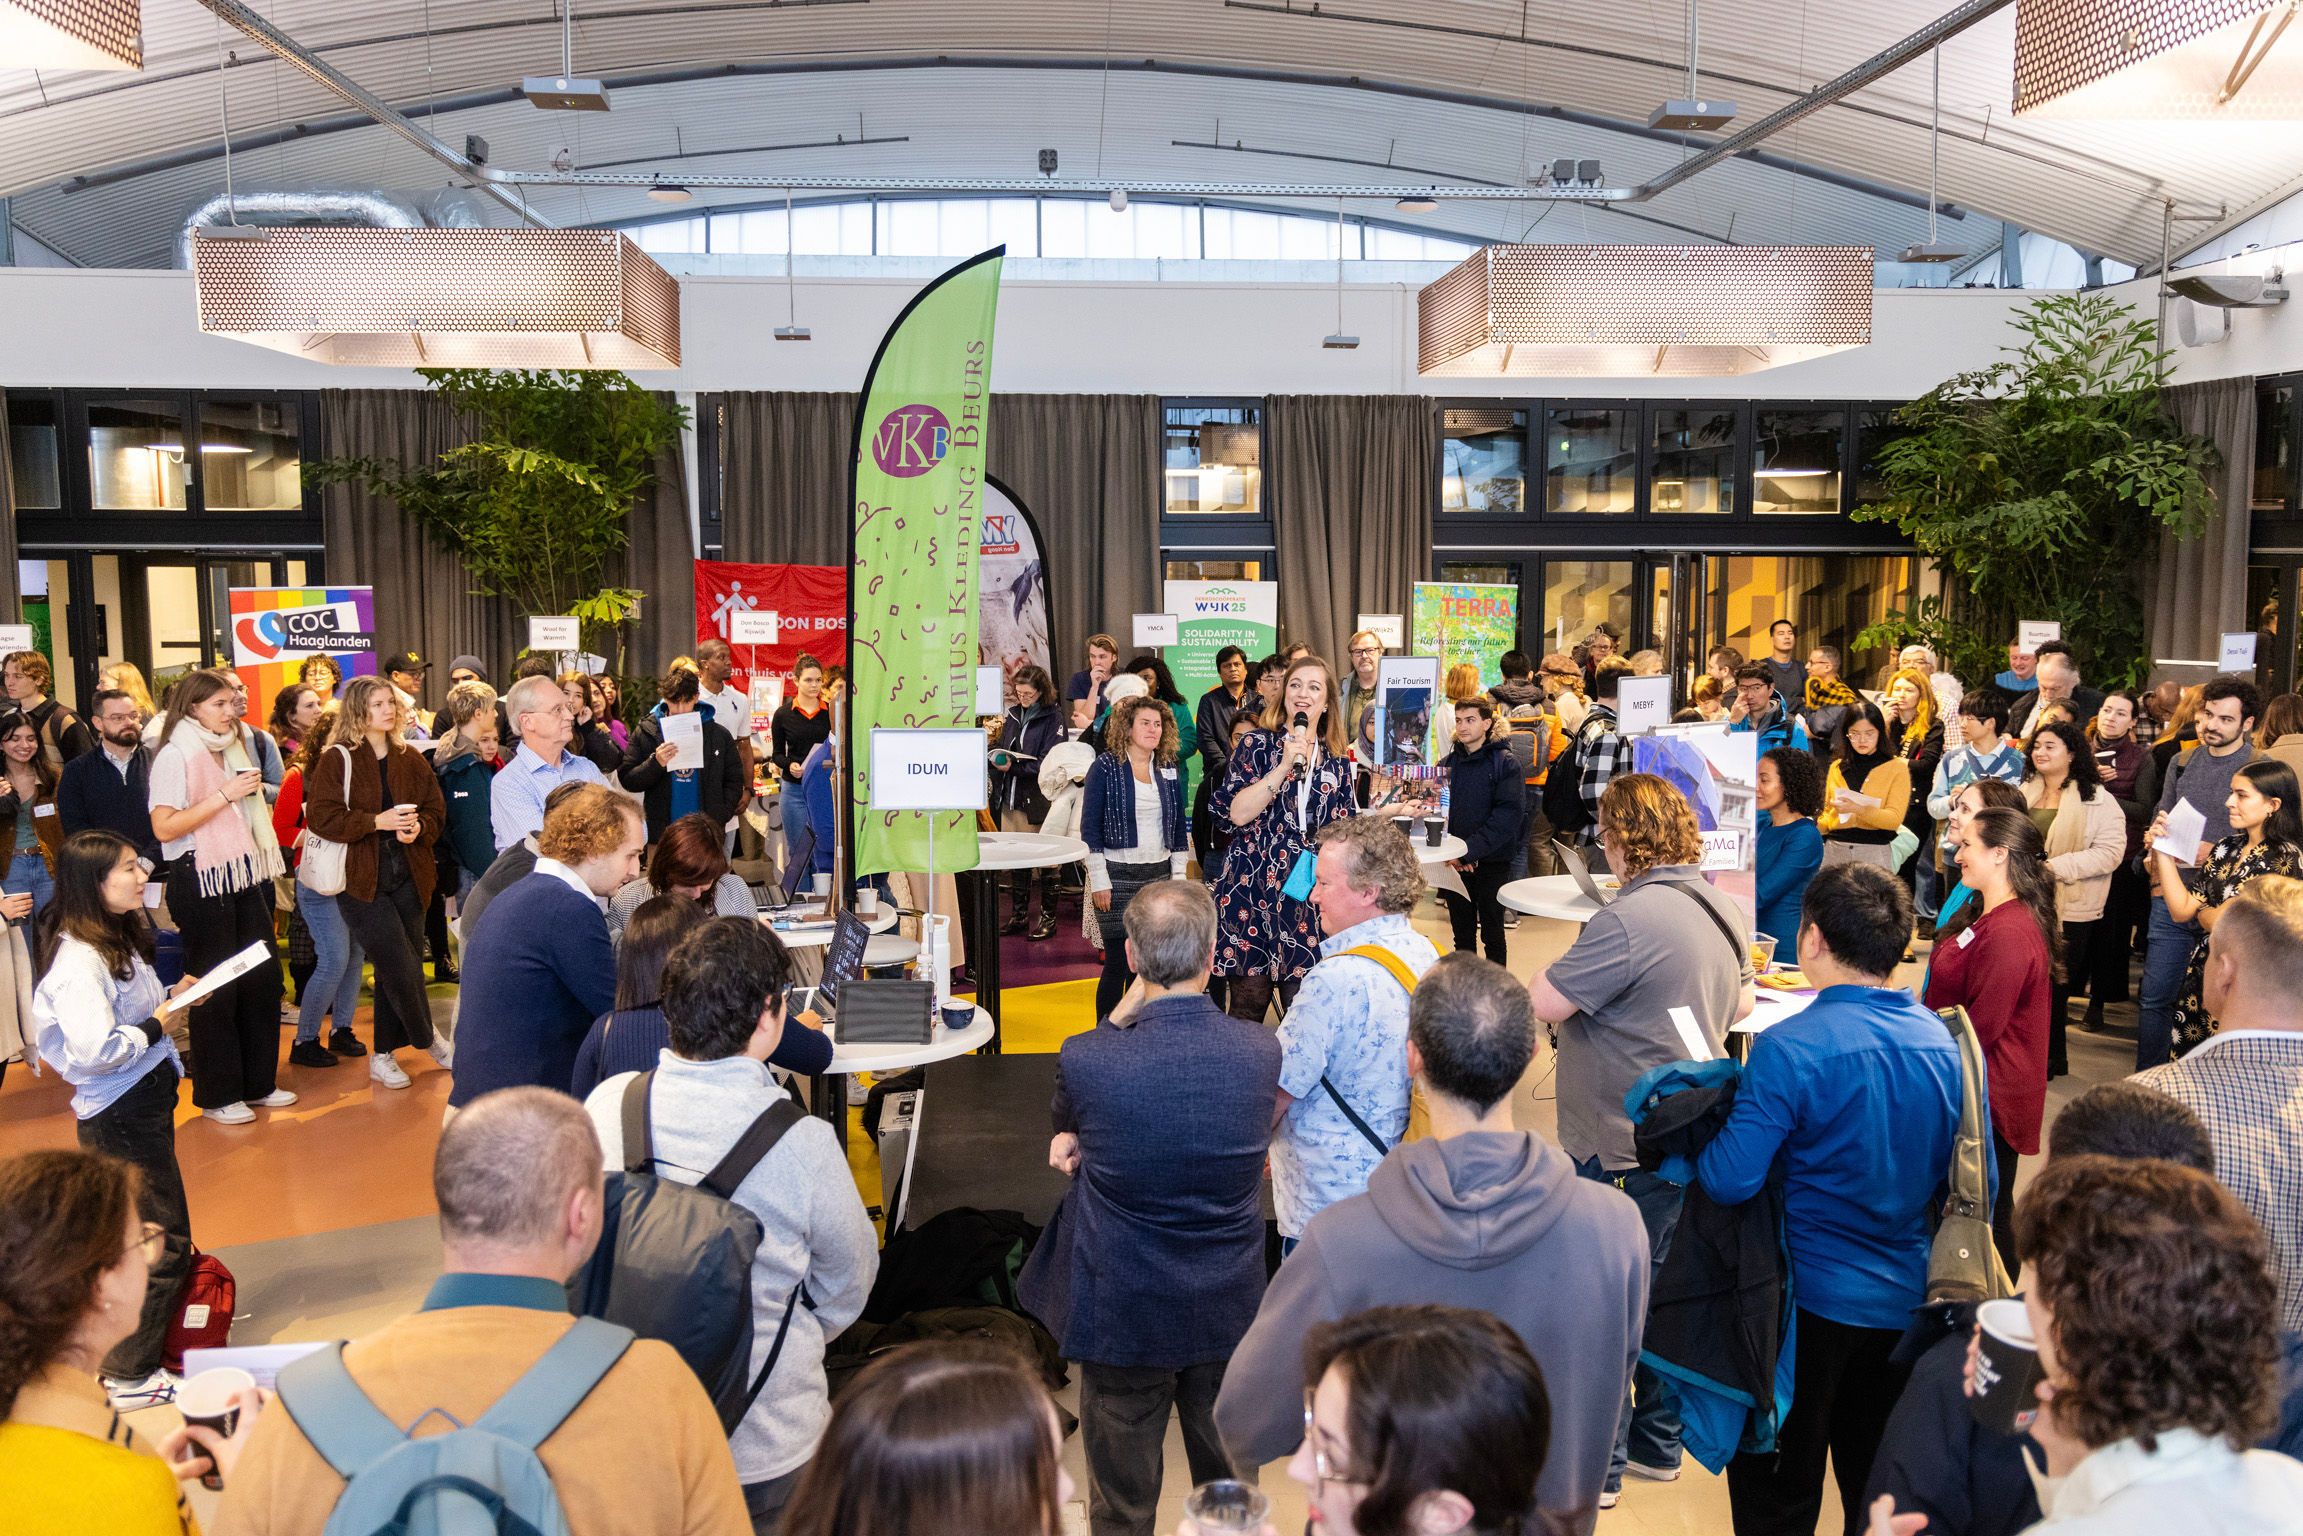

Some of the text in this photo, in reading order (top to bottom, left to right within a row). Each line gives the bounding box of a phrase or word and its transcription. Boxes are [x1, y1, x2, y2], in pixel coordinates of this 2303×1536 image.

[875, 414, 951, 468] VKB
[948, 340, 985, 727] NTIUS KLEDING BEURS
[1441, 597, 1512, 618] TERRA
[288, 611, 335, 633] COC
[814, 616, 847, 630] BOS
[1184, 629, 1256, 638] SOLIDARITY IN
[289, 634, 371, 649] Haaglanden
[1180, 638, 1260, 647] SUSTAINABILITY
[1419, 635, 1508, 648] Reforesting our future
[1447, 646, 1481, 656] together
[778, 670, 794, 680] vo
[1387, 677, 1431, 685] Fair Tourism
[1632, 700, 1654, 710] MEBYF
[907, 763, 948, 775] IDUM
[1704, 837, 1736, 851] aMa
